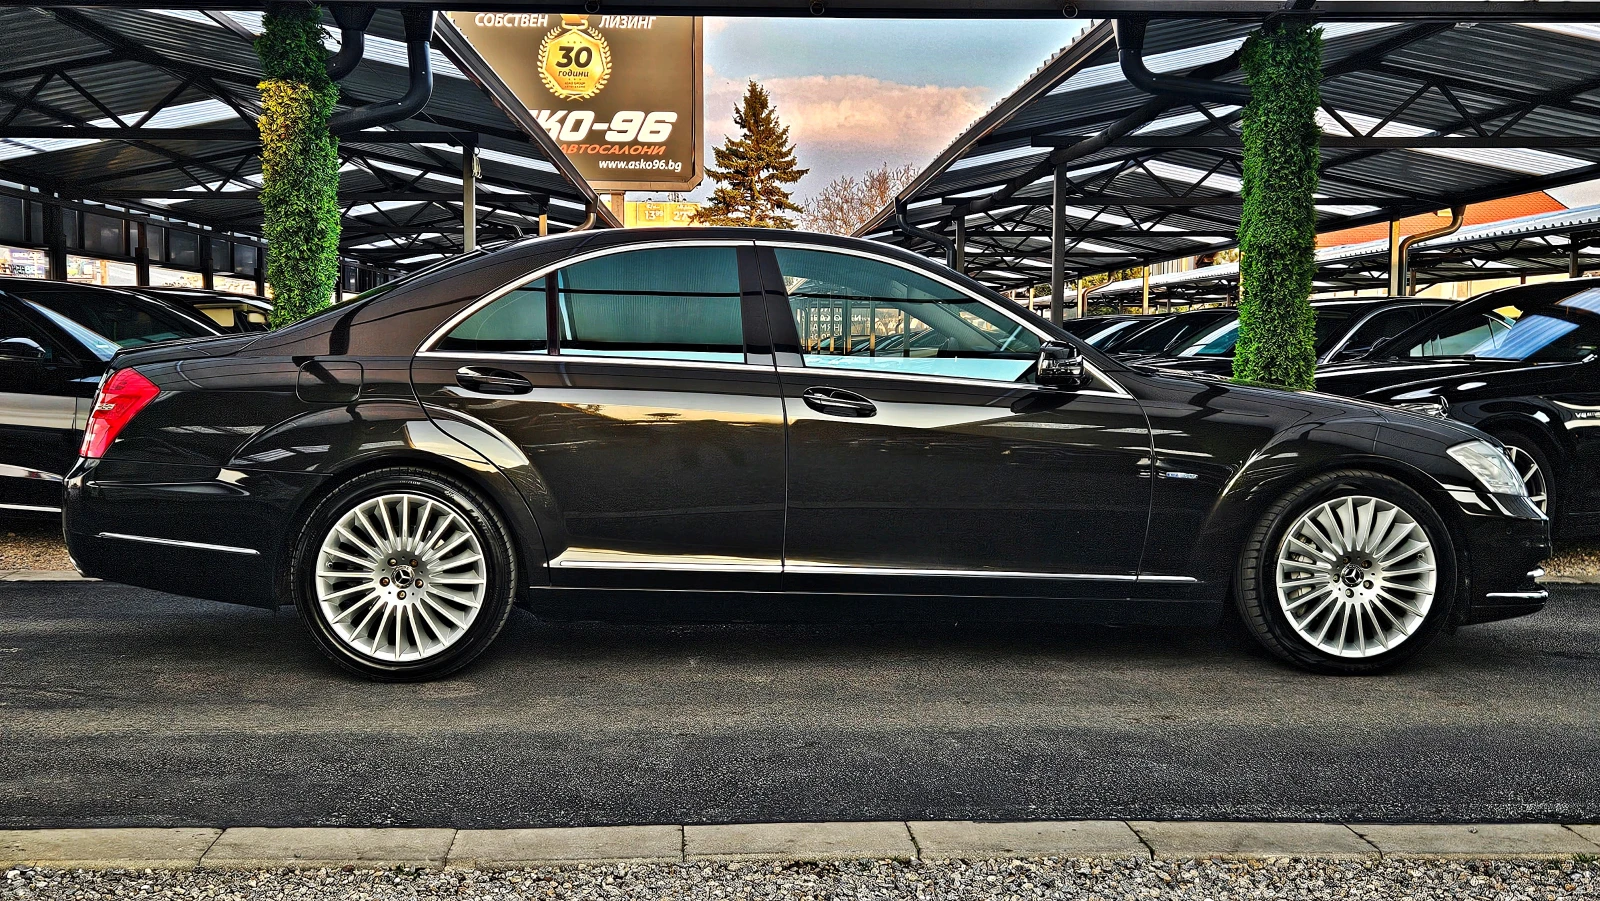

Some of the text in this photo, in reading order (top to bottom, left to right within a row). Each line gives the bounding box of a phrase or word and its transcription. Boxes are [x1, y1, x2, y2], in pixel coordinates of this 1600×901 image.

[474, 13, 657, 29] СОБСТВЕН ЛИЗИНГ
[555, 45, 593, 69] 30
[557, 68, 589, 78] години
[560, 144, 666, 155] АВТОСАЛОНИ
[598, 159, 682, 172] www.asko96.bg
